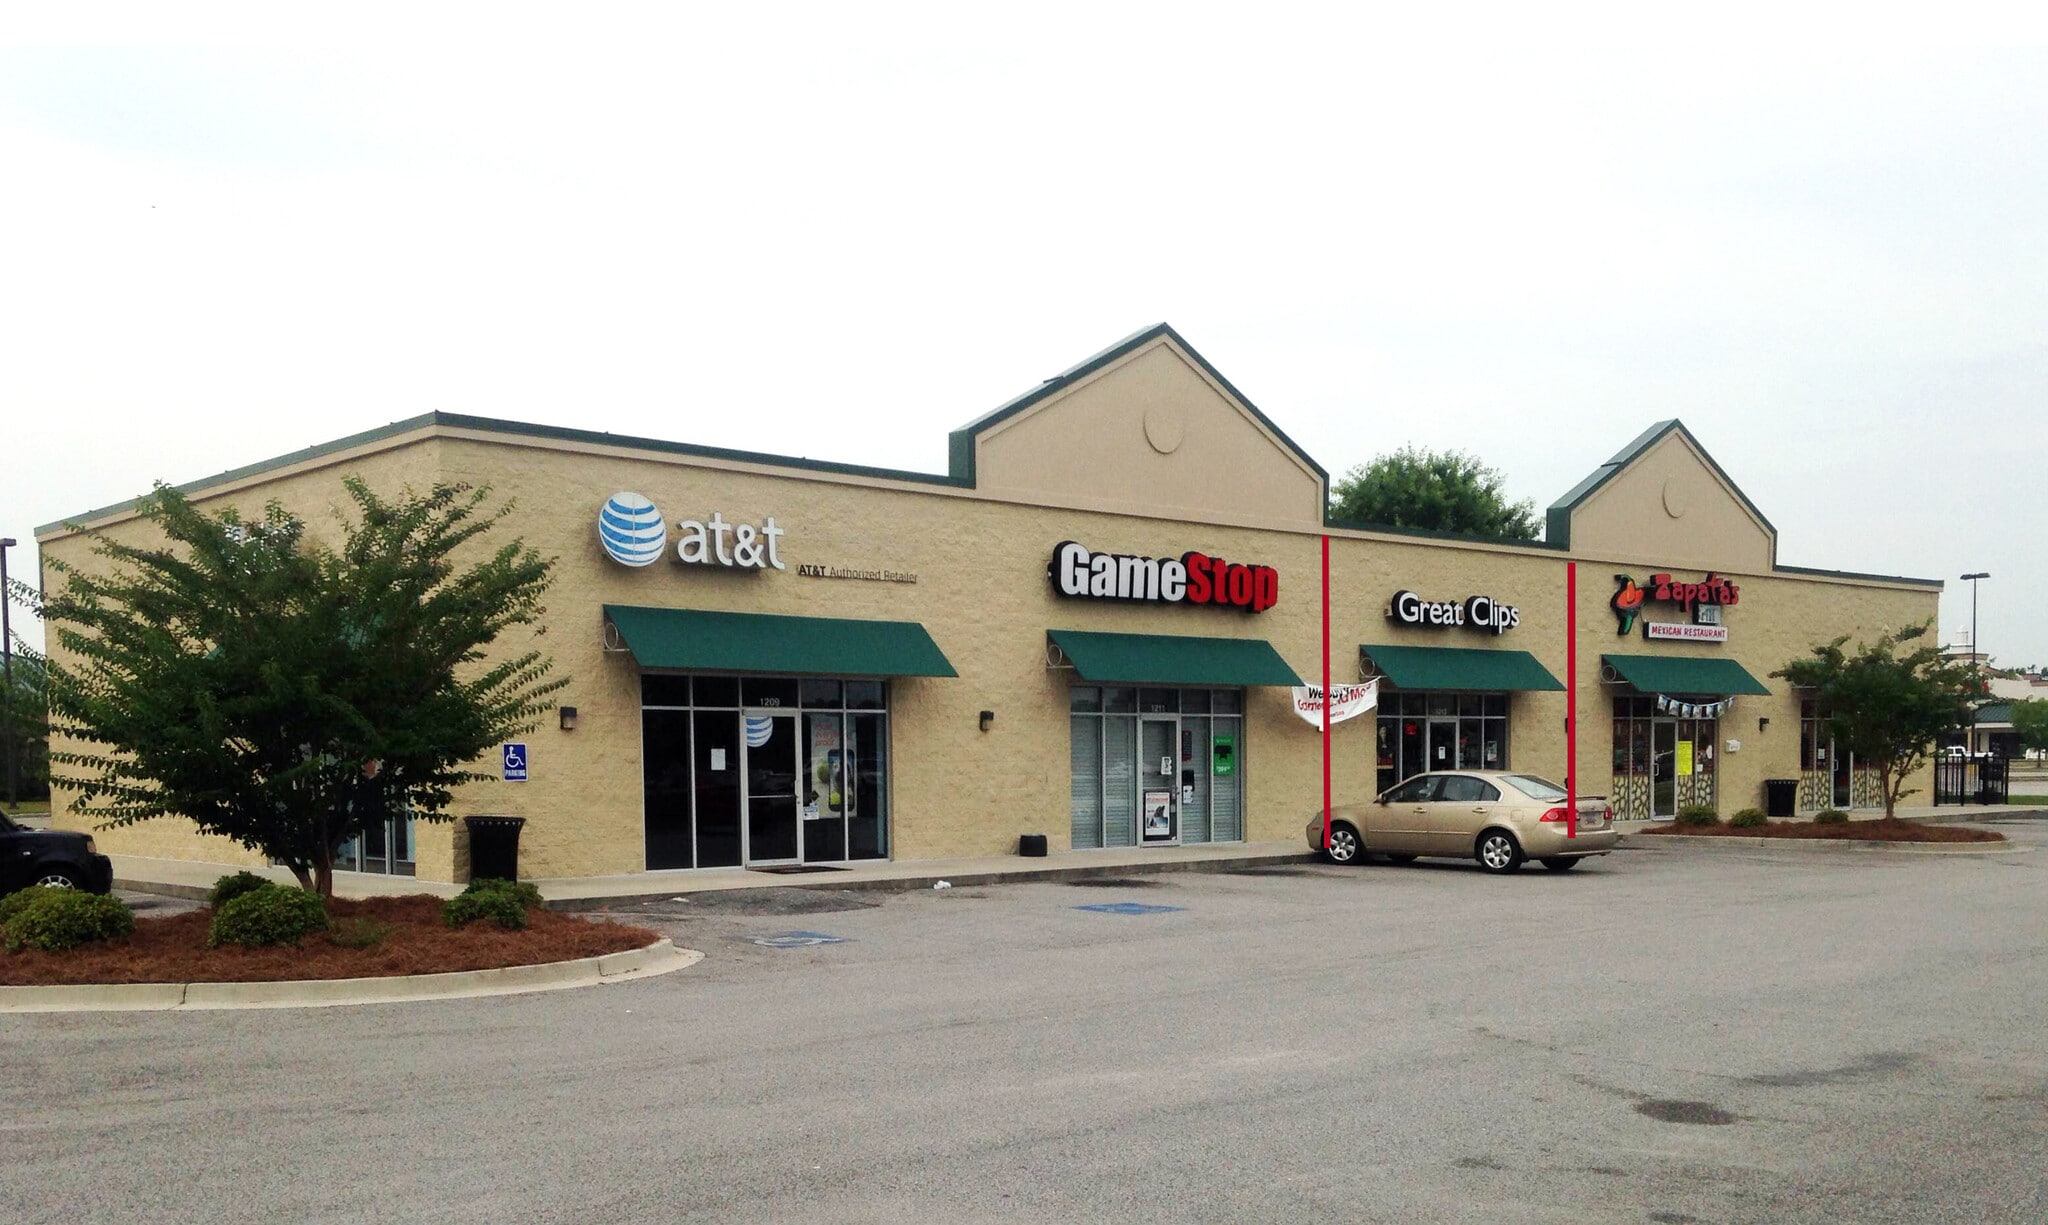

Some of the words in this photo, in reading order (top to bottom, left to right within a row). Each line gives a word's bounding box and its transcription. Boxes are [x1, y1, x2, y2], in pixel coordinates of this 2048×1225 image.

[676, 511, 785, 570] at&t
[798, 564, 826, 577] AT&T
[829, 566, 881, 580] Authorized
[883, 570, 918, 584] Retailer
[1056, 541, 1279, 612] GameStop
[1394, 590, 1464, 625] Great
[1469, 596, 1520, 634] Clips
[1651, 625, 1682, 636] MEXICAN
[1684, 627, 1726, 639] RESTAURANT
[760, 697, 780, 706] 1209
